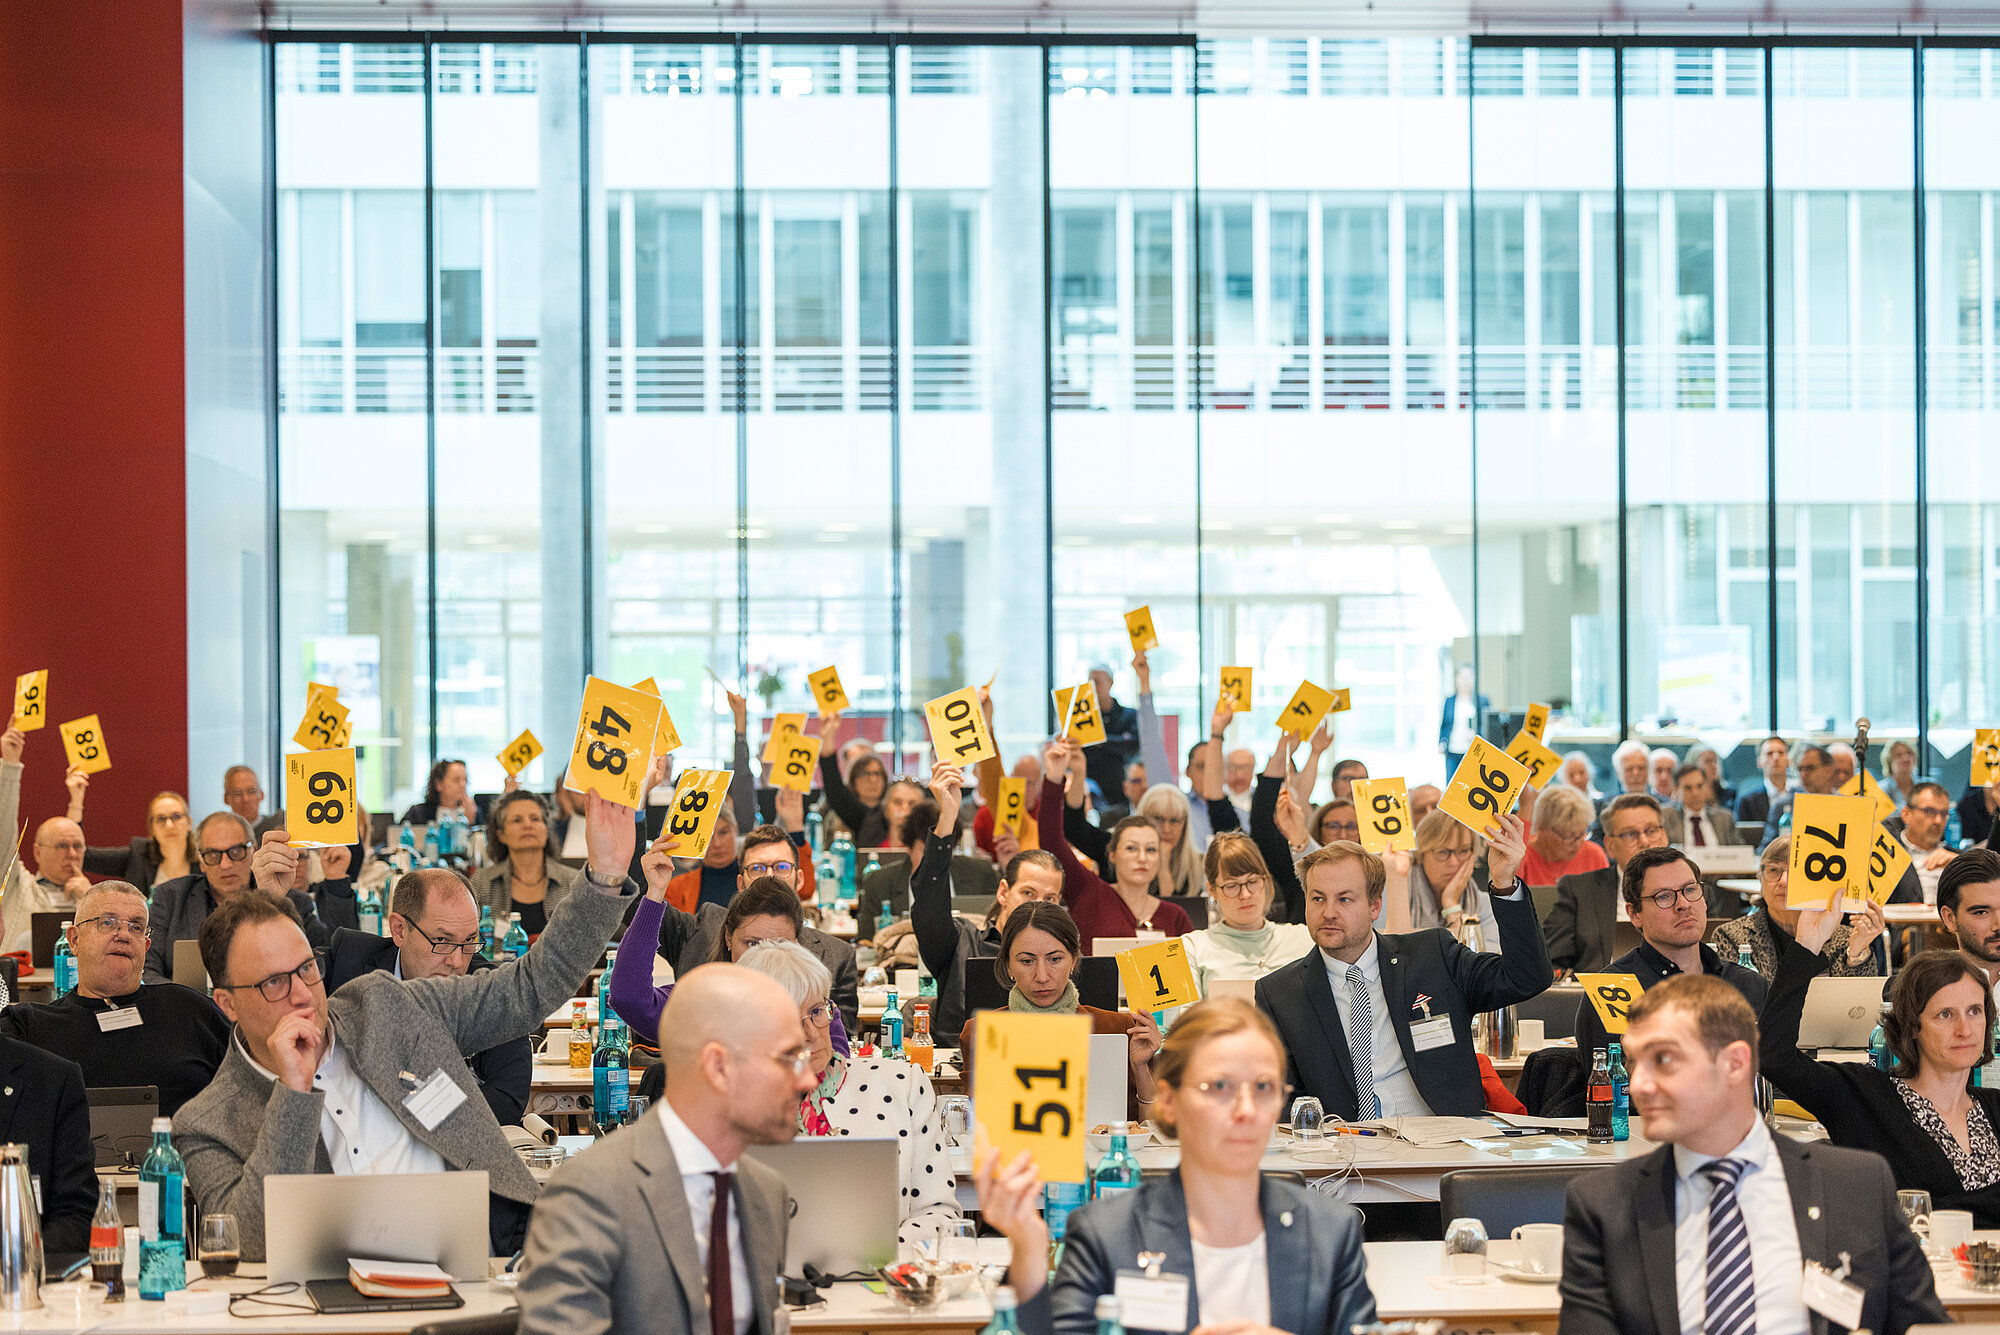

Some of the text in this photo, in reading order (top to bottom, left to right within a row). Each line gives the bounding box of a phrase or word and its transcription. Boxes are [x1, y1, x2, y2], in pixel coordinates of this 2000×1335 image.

[24, 685, 40, 717] 56
[1292, 701, 1312, 716] 4
[75, 729, 99, 761] 68
[310, 710, 339, 744] 35
[586, 705, 632, 776] 48
[944, 700, 982, 758] 110
[786, 747, 812, 777] 93
[1515, 750, 1545, 778] 45
[306, 772, 346, 824] 89
[1007, 792, 1020, 822] 10
[1467, 764, 1510, 815] 96
[671, 790, 709, 836] 83
[1373, 795, 1401, 834] 69
[1805, 824, 1846, 881] 78
[1868, 833, 1896, 893] 10
[1150, 965, 1169, 996] 1
[1597, 986, 1632, 1018] 82
[1012, 1059, 1071, 1138] 51
